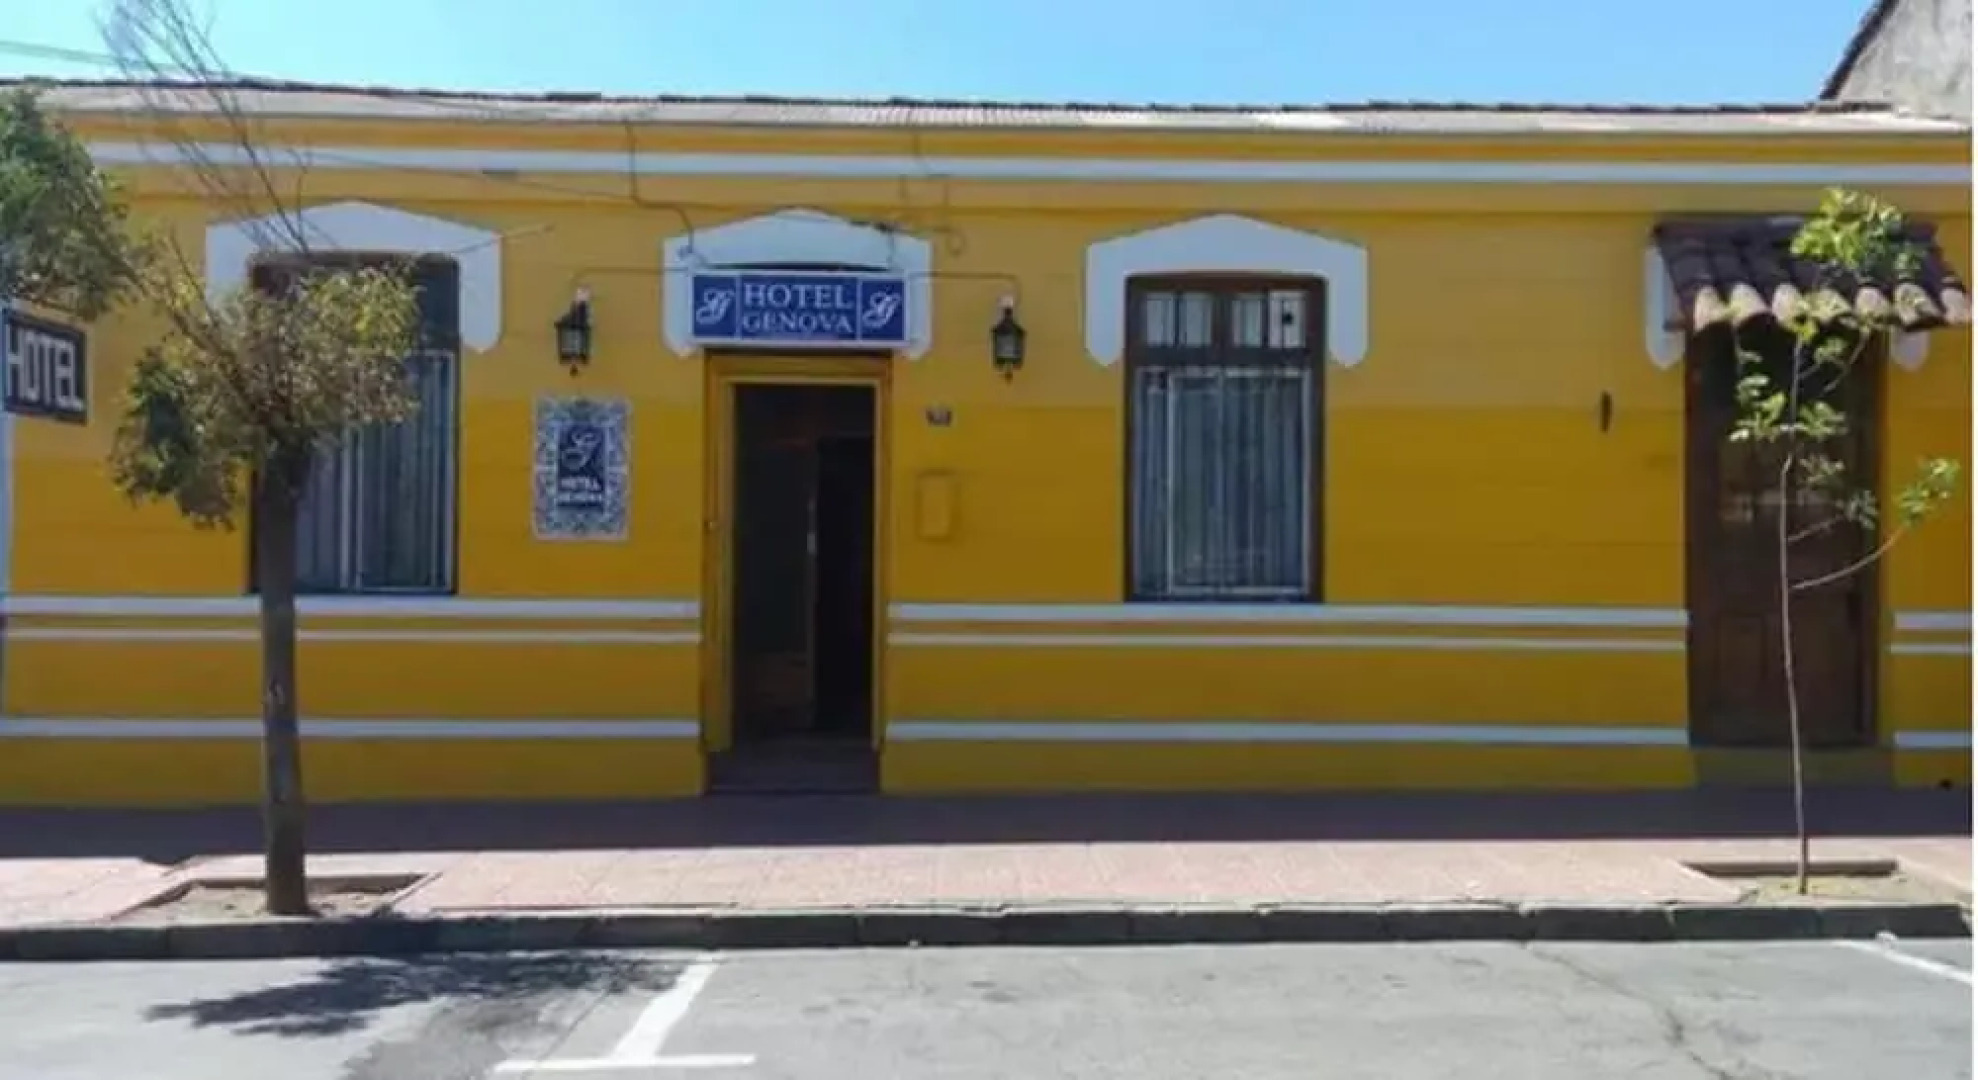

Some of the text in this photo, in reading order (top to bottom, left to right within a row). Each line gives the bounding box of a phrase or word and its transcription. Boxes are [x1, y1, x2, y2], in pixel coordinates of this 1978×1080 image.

[744, 283, 855, 309] HOTEL
[743, 310, 853, 333] GENOVA
[5, 326, 84, 409] HOTEL
